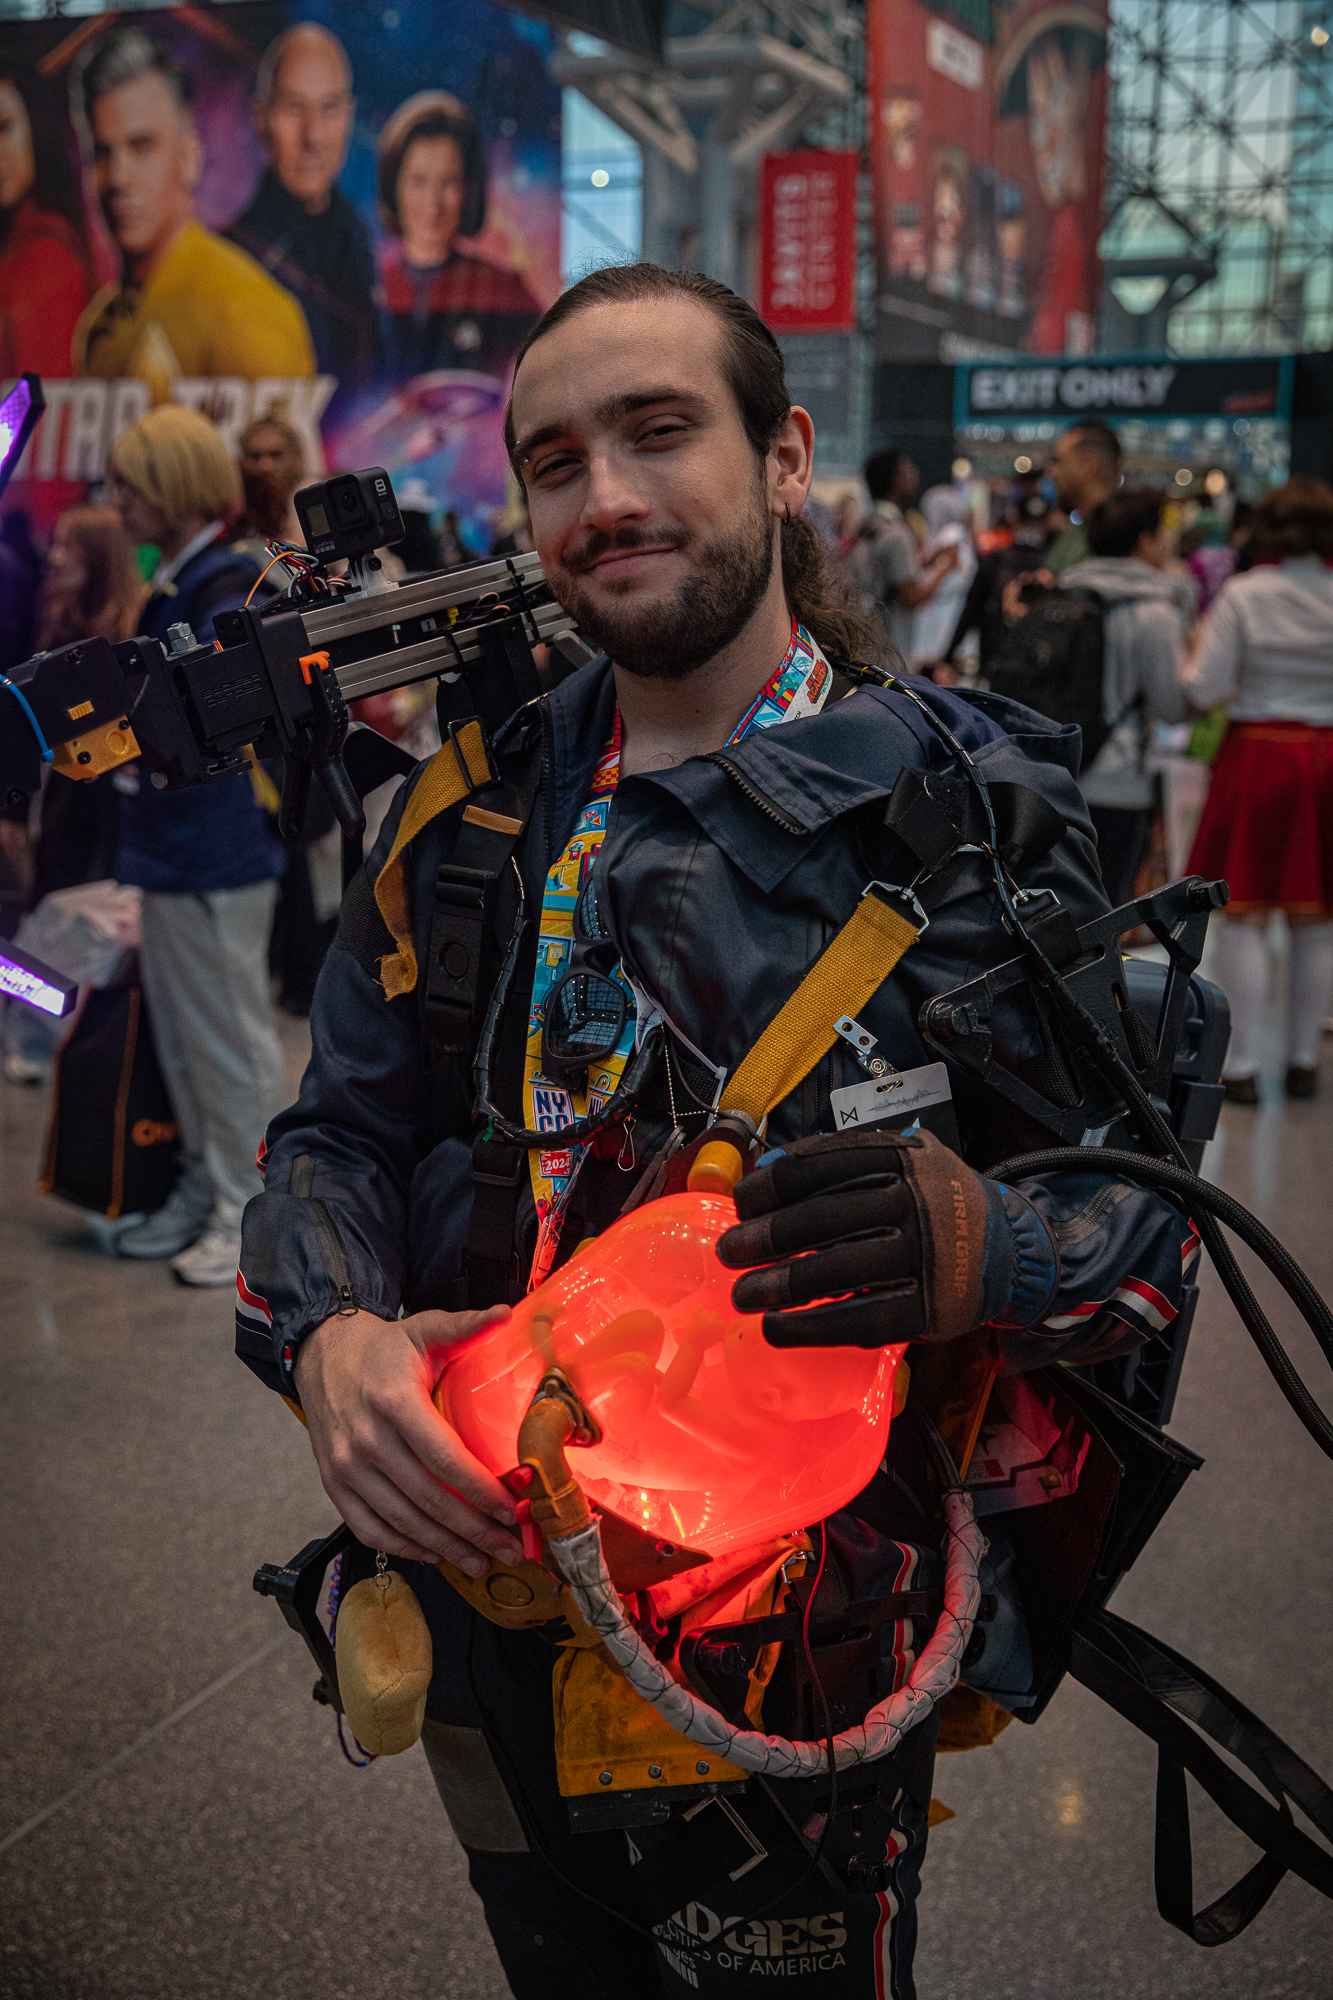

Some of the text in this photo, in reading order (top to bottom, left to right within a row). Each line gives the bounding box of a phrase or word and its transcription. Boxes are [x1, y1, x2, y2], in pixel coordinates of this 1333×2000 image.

[972, 368, 1058, 408] EXIT
[1060, 366, 1174, 407] ONLY
[375, 479, 386, 492] 8
[536, 1091, 566, 1115] NY
[544, 1157, 570, 1171] 2024
[951, 1180, 968, 1298] FIRM GRIP
[671, 1901, 848, 1957] DGES
[717, 1952, 743, 1972] OF
[750, 1952, 846, 1976] AMERICA
